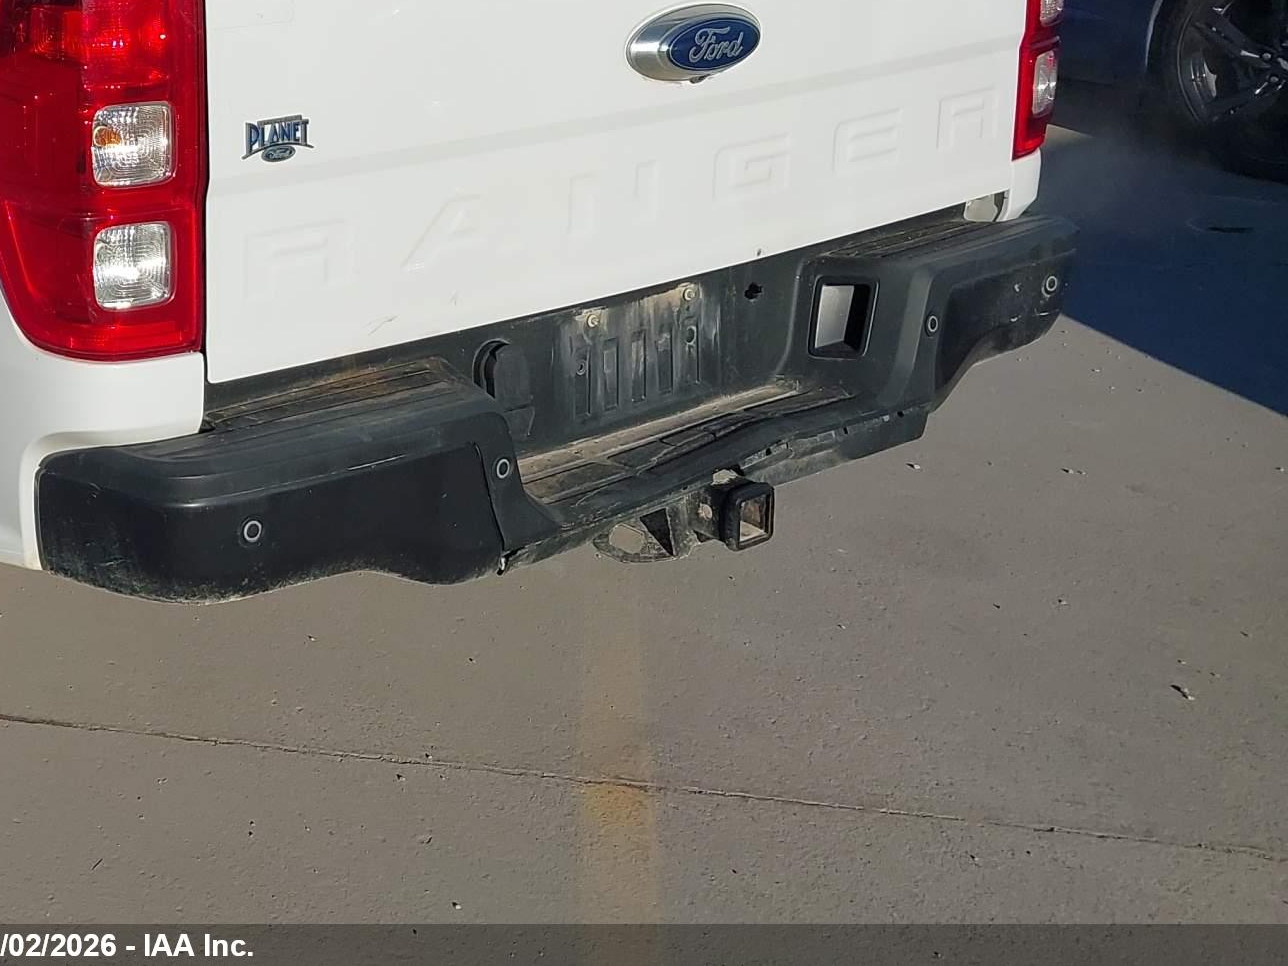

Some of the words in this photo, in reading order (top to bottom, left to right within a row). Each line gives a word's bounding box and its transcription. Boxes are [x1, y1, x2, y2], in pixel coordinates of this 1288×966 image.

[689, 27, 744, 63] Ford
[245, 119, 310, 155] PLANET
[243, 90, 998, 302] RANGER
